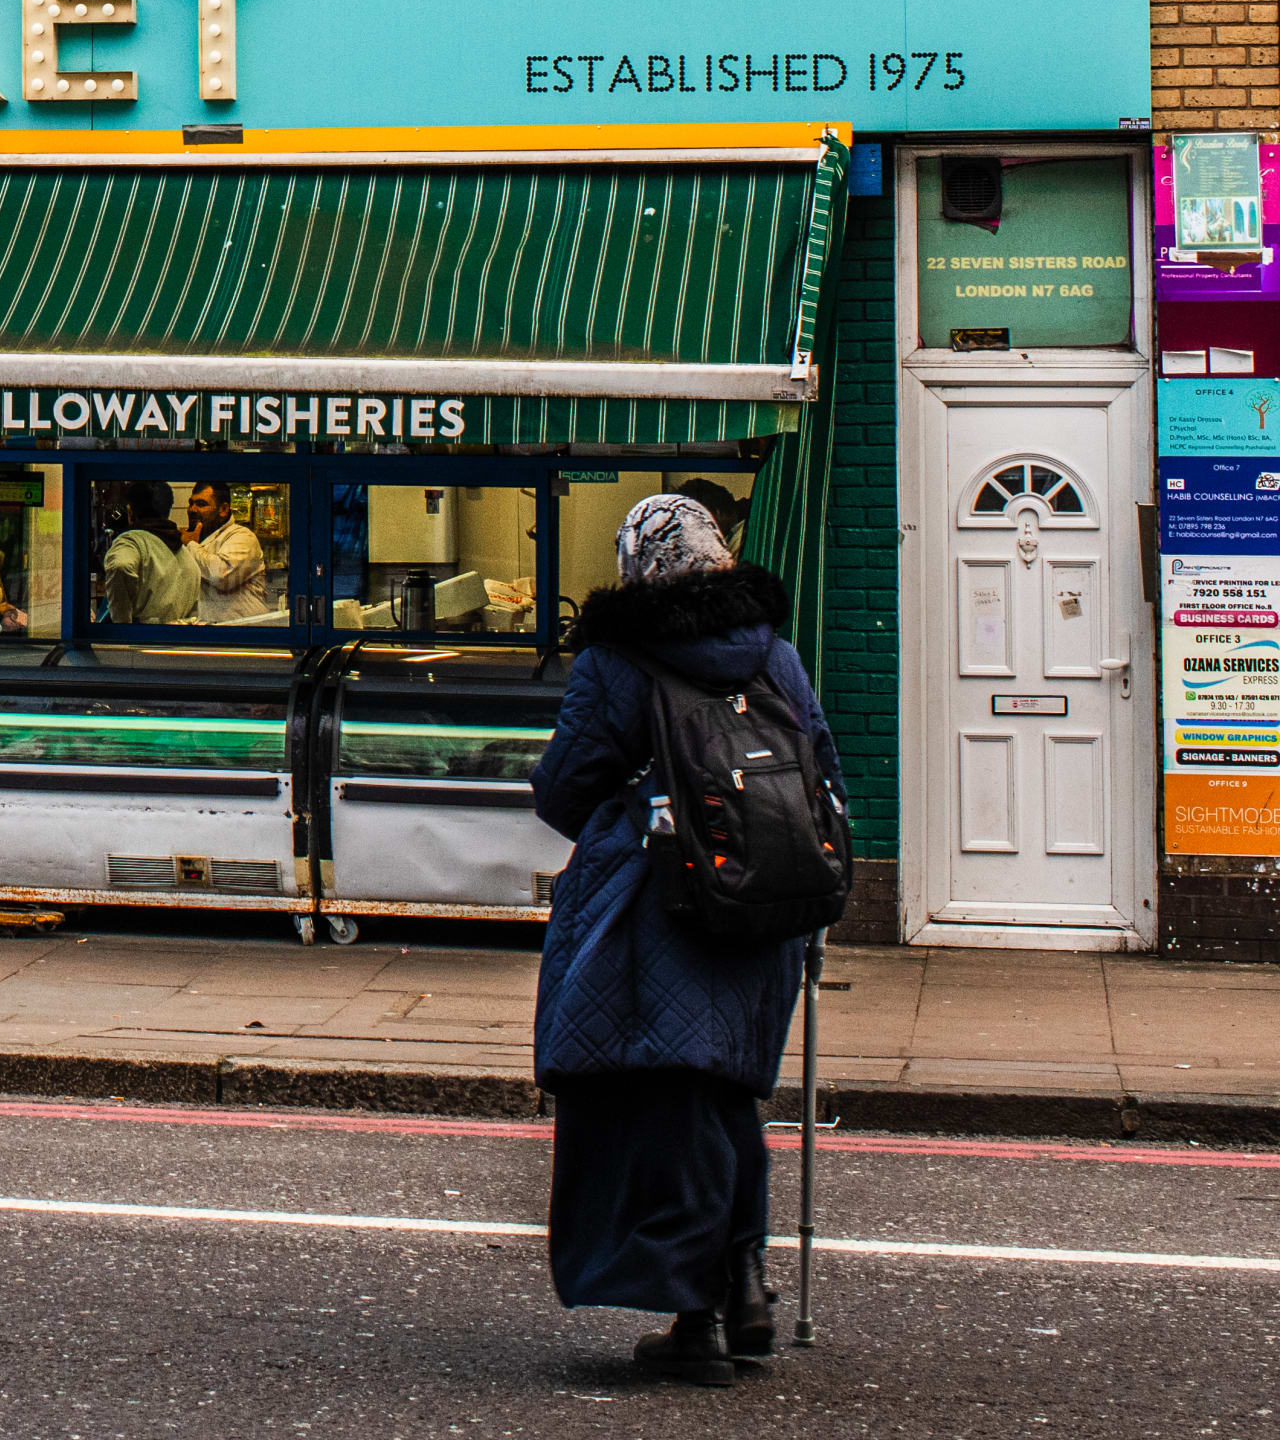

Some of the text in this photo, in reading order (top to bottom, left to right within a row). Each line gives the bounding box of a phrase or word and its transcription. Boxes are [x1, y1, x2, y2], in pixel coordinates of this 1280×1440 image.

[525, 51, 966, 95] ESTABLISHED 1975
[926, 256, 1127, 270] 22 SEVEN SISTERS ROAD
[955, 284, 1094, 298] LONDON N7 6AG
[1195, 388, 1227, 396] OFFICE
[211, 394, 466, 439] FISHERIES
[1169, 480, 1182, 488] HC
[1167, 492, 1254, 501] HABIB COUNSELLING
[1222, 588, 1243, 597] 558
[1246, 589, 1267, 598] 151
[1179, 613, 1275, 624] BUSINESS CARDS
[1195, 634, 1241, 644] OFFICE 3
[1183, 657, 1279, 672] OZANA SERVICES
[1242, 675, 1278, 685] EXPRESS
[1210, 701, 1255, 710] 9.30 17.30
[1182, 733, 1278, 742] WINDOW GRAPHICS
[1182, 752, 1225, 761] SIGNAGE
[1231, 753, 1277, 762] BANNERS
[1175, 824, 1240, 835] SUSTAINABLE
